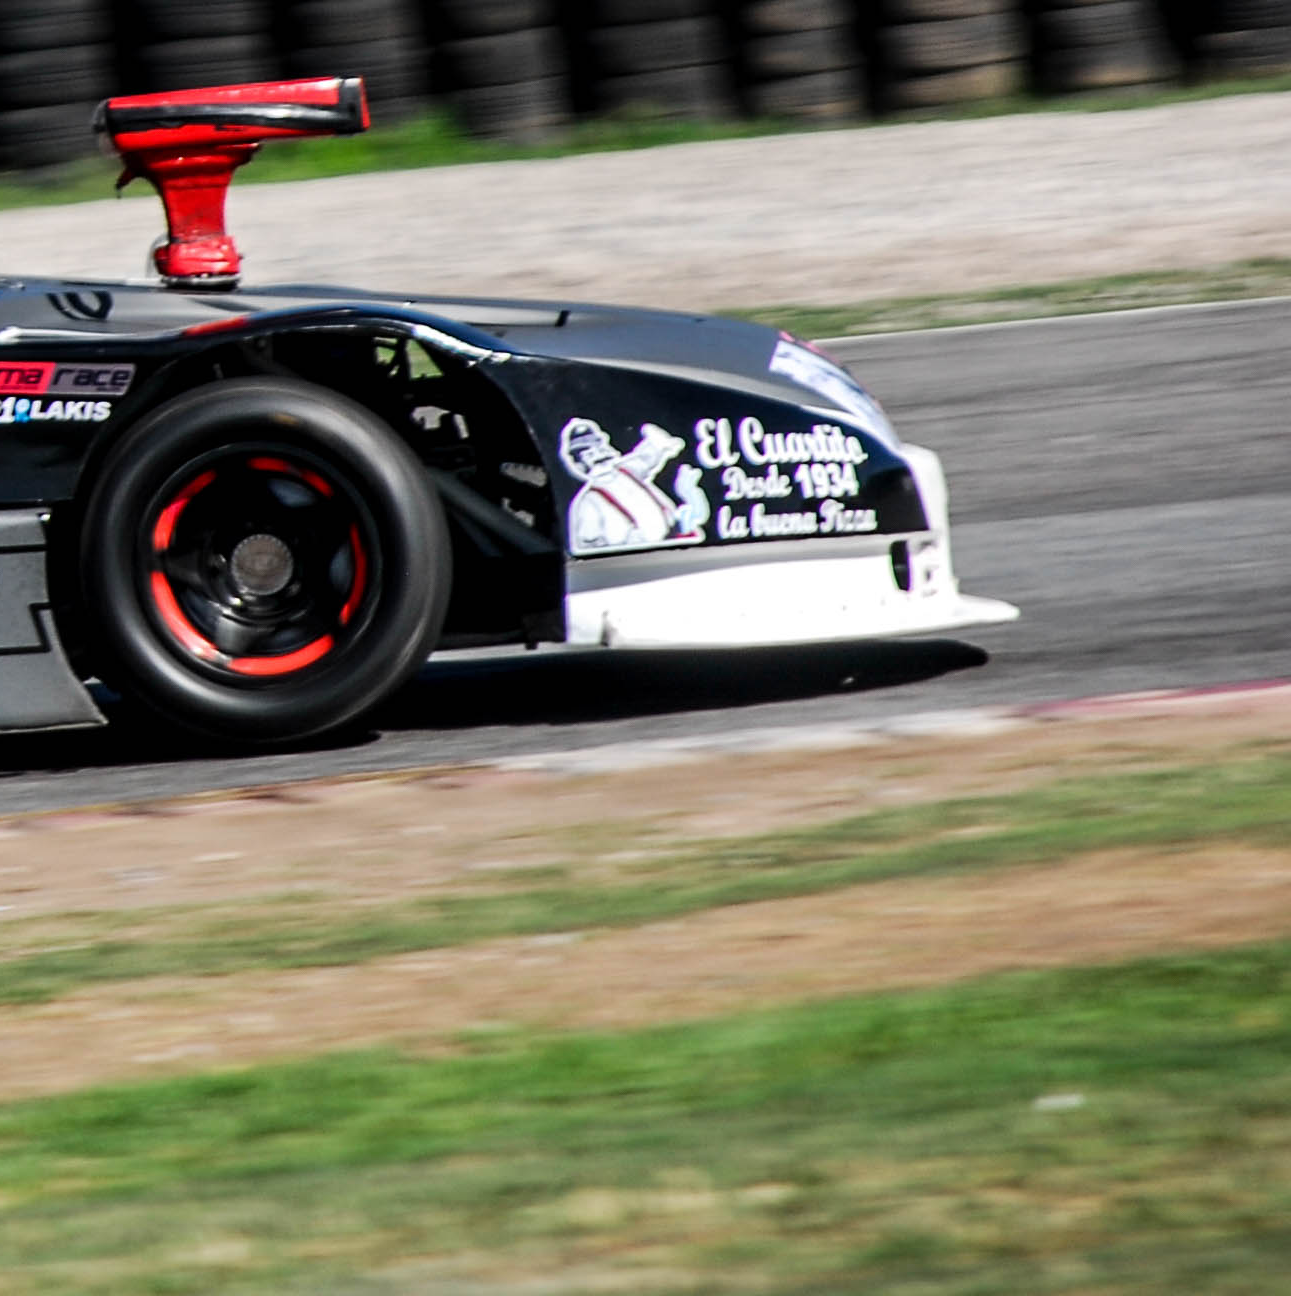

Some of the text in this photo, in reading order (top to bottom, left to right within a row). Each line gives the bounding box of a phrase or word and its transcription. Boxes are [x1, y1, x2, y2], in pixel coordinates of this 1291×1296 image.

[52, 367, 132, 387] race
[695, 418, 740, 469] El
[722, 462, 860, 501] Desde 1934
